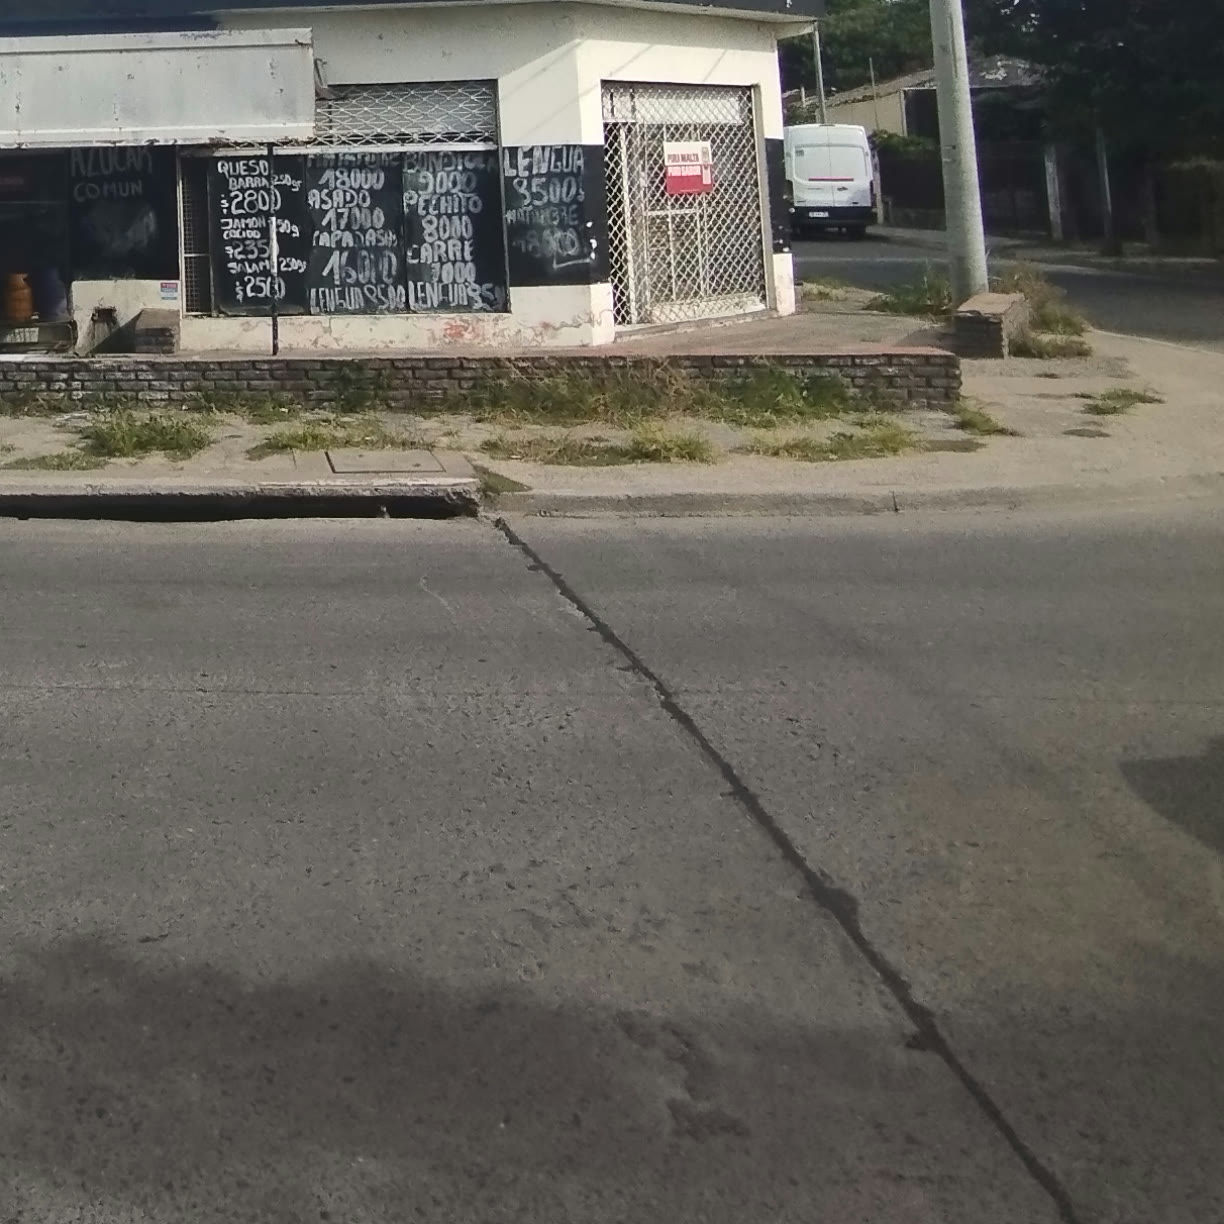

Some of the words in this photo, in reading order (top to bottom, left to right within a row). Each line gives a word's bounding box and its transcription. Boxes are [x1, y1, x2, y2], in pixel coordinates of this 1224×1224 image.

[217, 160, 269, 179] QUESO
[503, 145, 584, 177] LENGUA
[74, 180, 143, 202] COMUN
[228, 177, 269, 191] BARRA
[318, 168, 385, 191] 18000
[417, 171, 477, 194] 9000
[307, 189, 371, 210] ASADO
[403, 191, 483, 215] PECHITO
[220, 218, 266, 230] JAMON
[321, 207, 385, 232] 17000
[421, 214, 473, 243] 8000
[222, 230, 261, 239] COCIDO
[407, 239, 474, 264] CARRE
[431, 262, 476, 284] 7000
[310, 286, 364, 313] LENGUA
[408, 280, 468, 310] LENGUA
